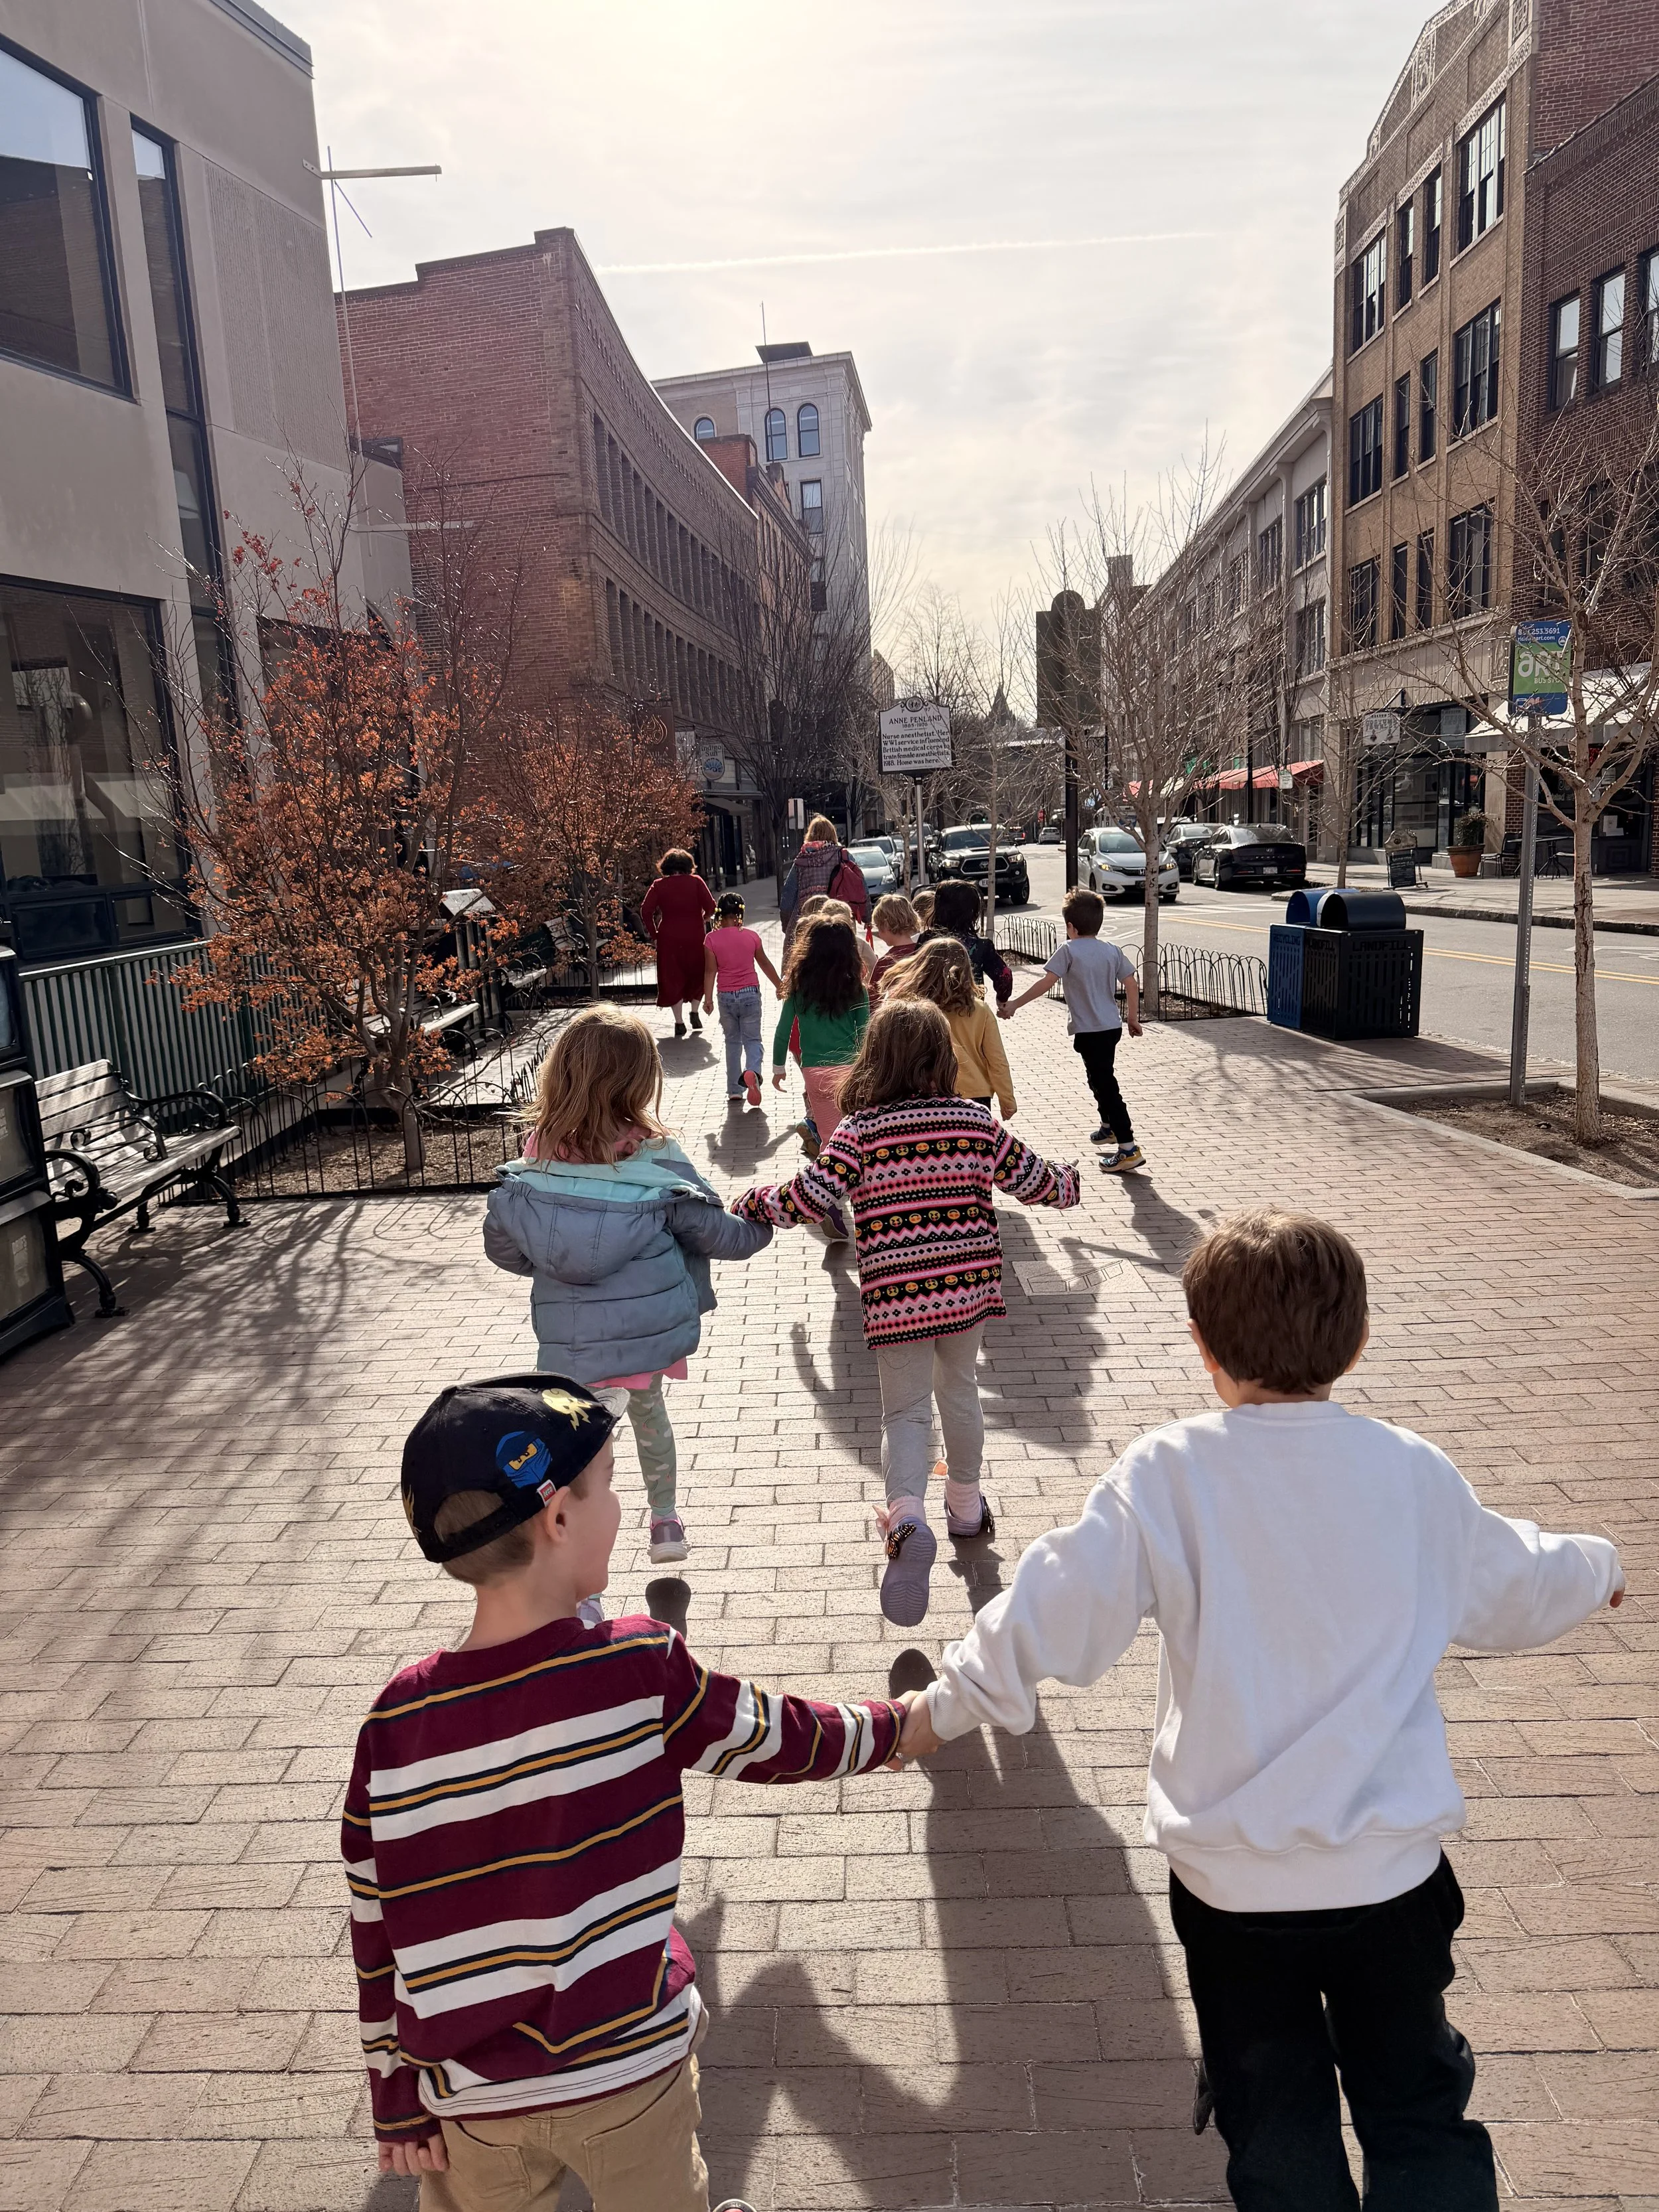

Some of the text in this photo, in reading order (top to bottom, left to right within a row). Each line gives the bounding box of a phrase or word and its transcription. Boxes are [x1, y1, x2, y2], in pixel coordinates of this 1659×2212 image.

[910, 715, 942, 723] PENLAND
[1273, 933, 1301, 946] RECYCLING
[1308, 938, 1335, 951] LANDFILL
[1352, 939, 1408, 952] LANDFILL
